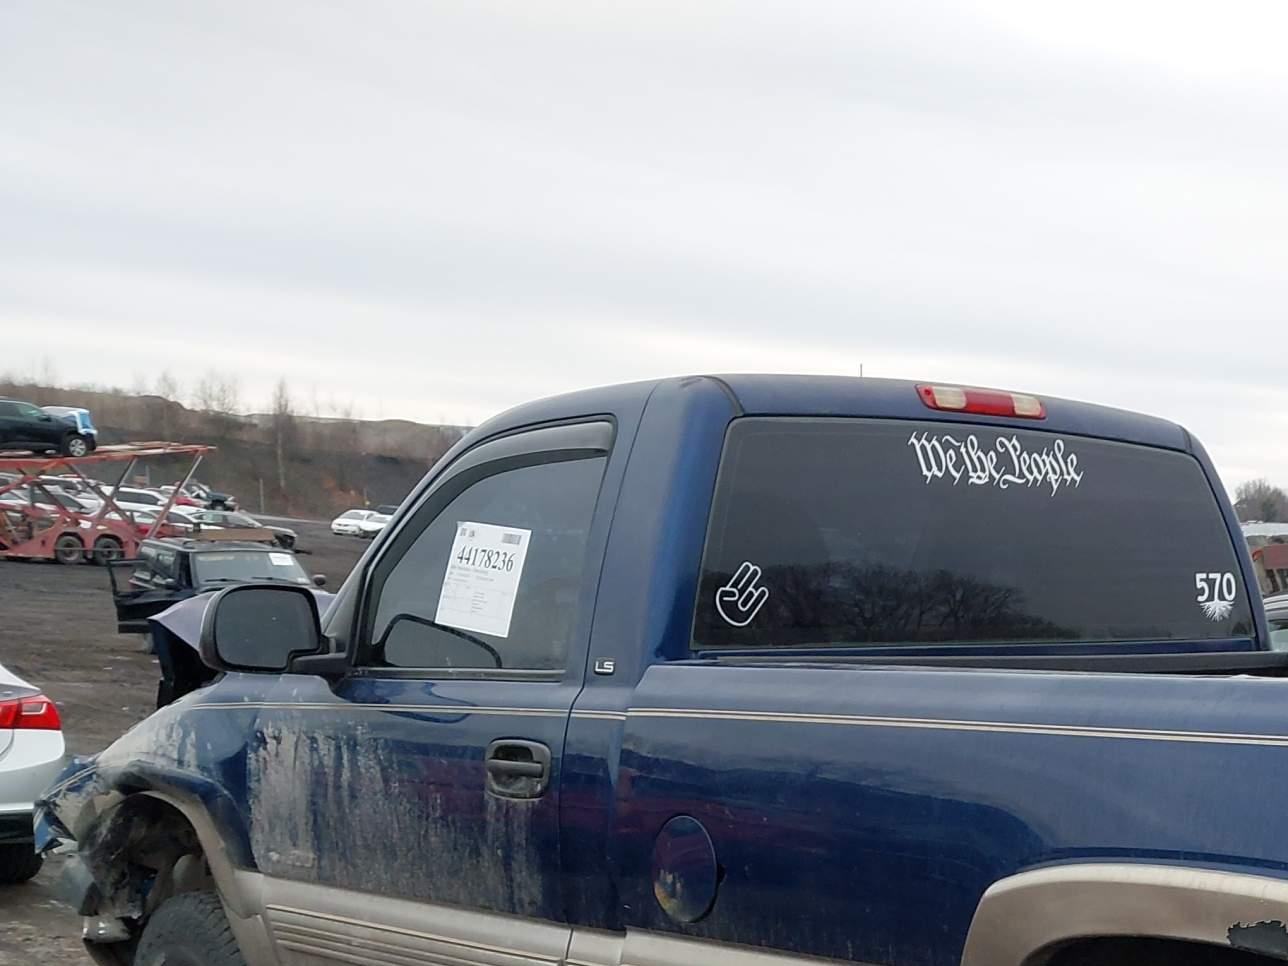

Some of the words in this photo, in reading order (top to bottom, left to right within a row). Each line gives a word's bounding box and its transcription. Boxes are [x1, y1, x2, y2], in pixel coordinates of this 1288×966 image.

[908, 432, 966, 485] We
[960, 435, 1006, 485] the
[996, 435, 1084, 497] People
[457, 544, 516, 572] 44178236
[1195, 572, 1236, 602] 570
[594, 660, 615, 673] LS
